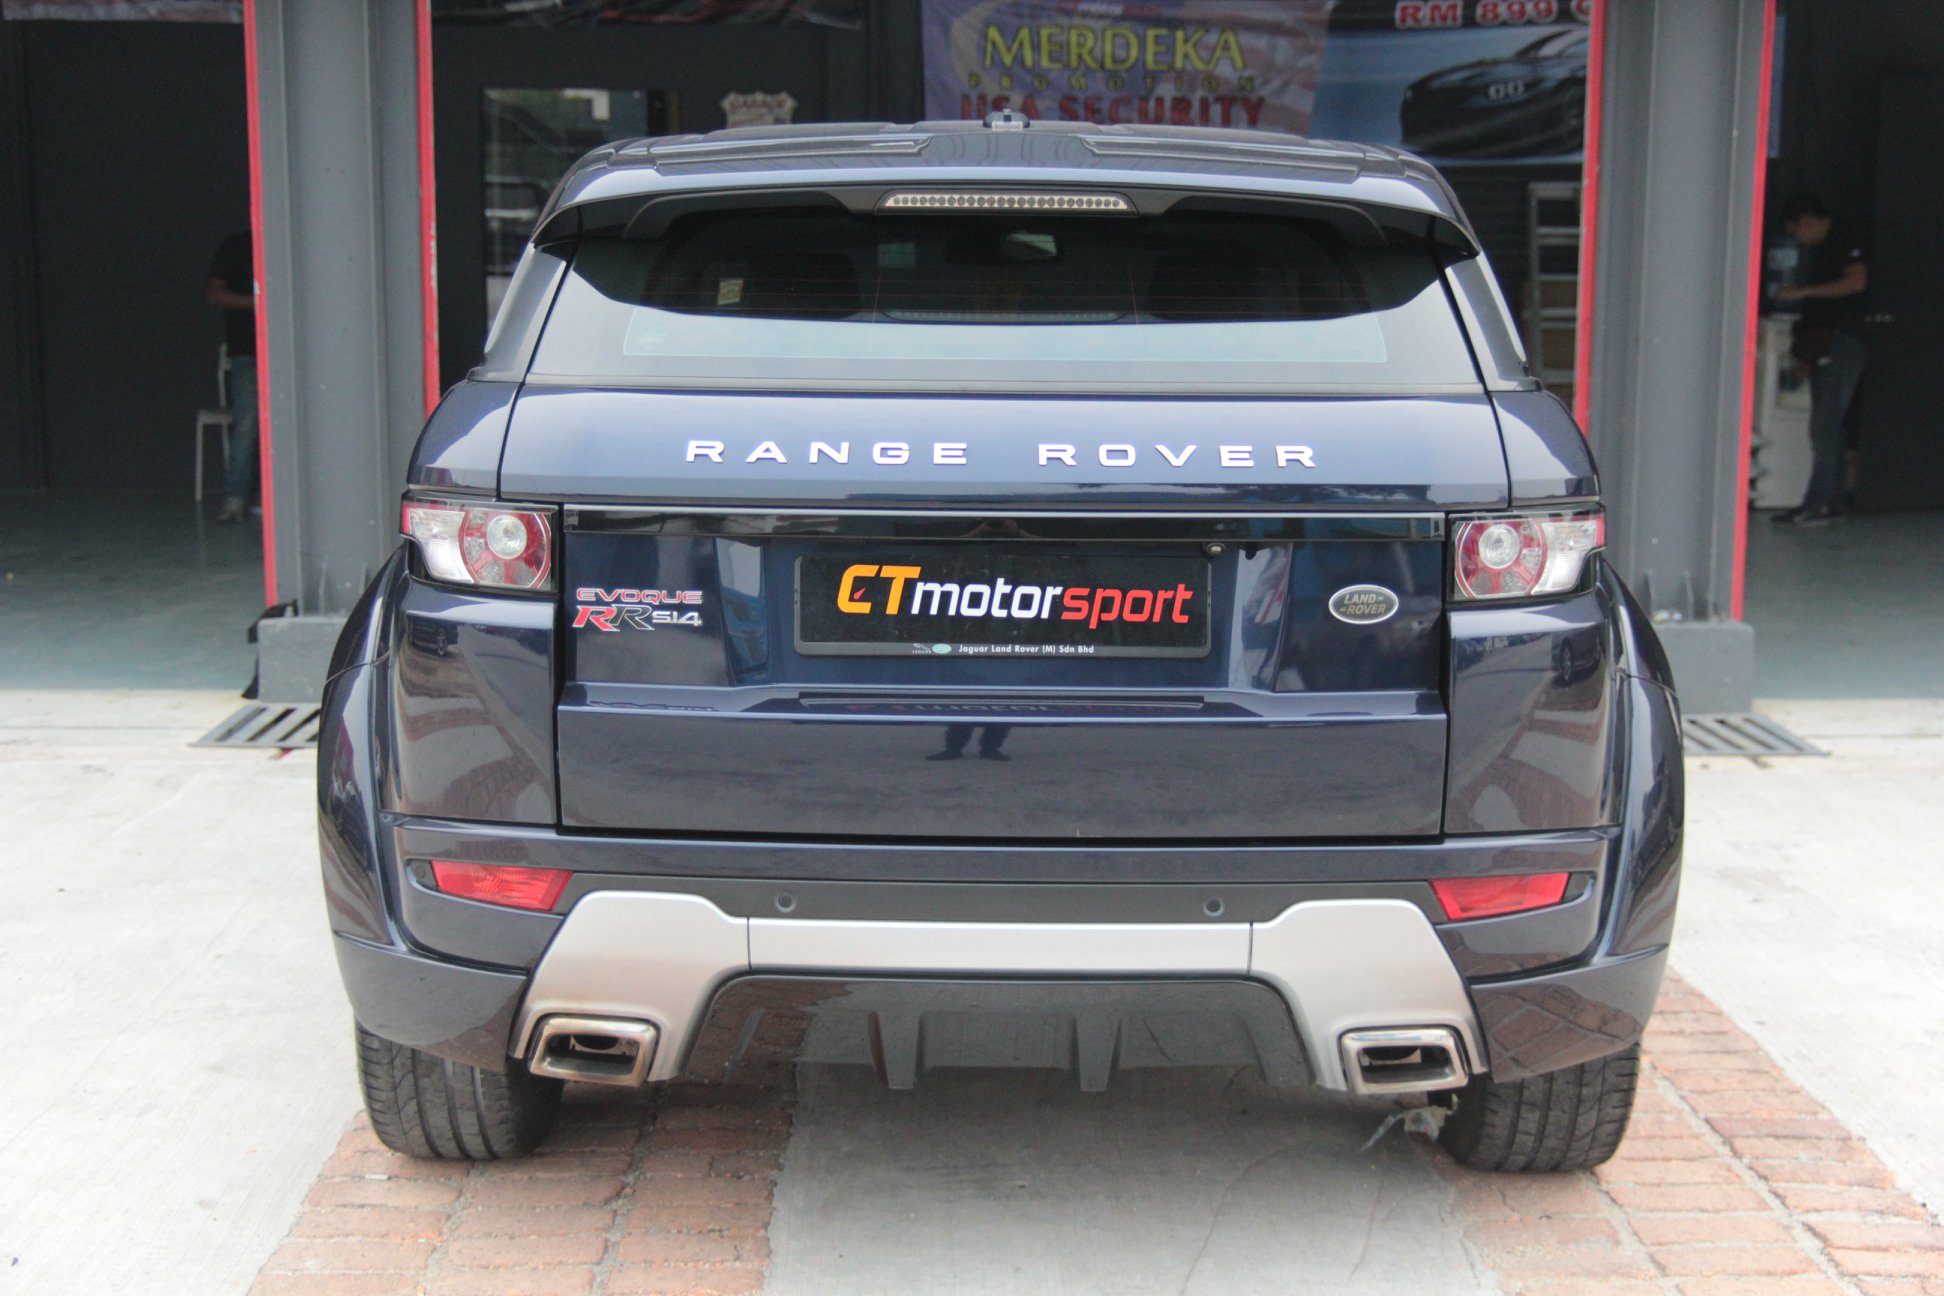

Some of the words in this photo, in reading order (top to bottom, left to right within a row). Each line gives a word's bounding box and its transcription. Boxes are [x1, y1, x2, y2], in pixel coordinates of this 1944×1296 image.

[1397, 2, 1461, 28] RM
[1476, 0, 1557, 26] 899
[984, 23, 1247, 71] MERDEKA
[967, 71, 1256, 92] PROMOTION
[1058, 96, 1266, 128] SECURITY
[685, 438, 968, 466] RANGE
[1037, 442, 1317, 469] ROVER
[576, 587, 703, 605] EVOQUE
[1343, 593, 1377, 605] LAND
[1346, 603, 1387, 615] ROVER
[958, 644, 989, 654] Jaguar
[991, 644, 1012, 653] Land
[1014, 645, 1039, 653] Rover
[1042, 645, 1056, 654] (M)
[1059, 645, 1075, 654] Sdn
[1077, 645, 1094, 654] Bhd
